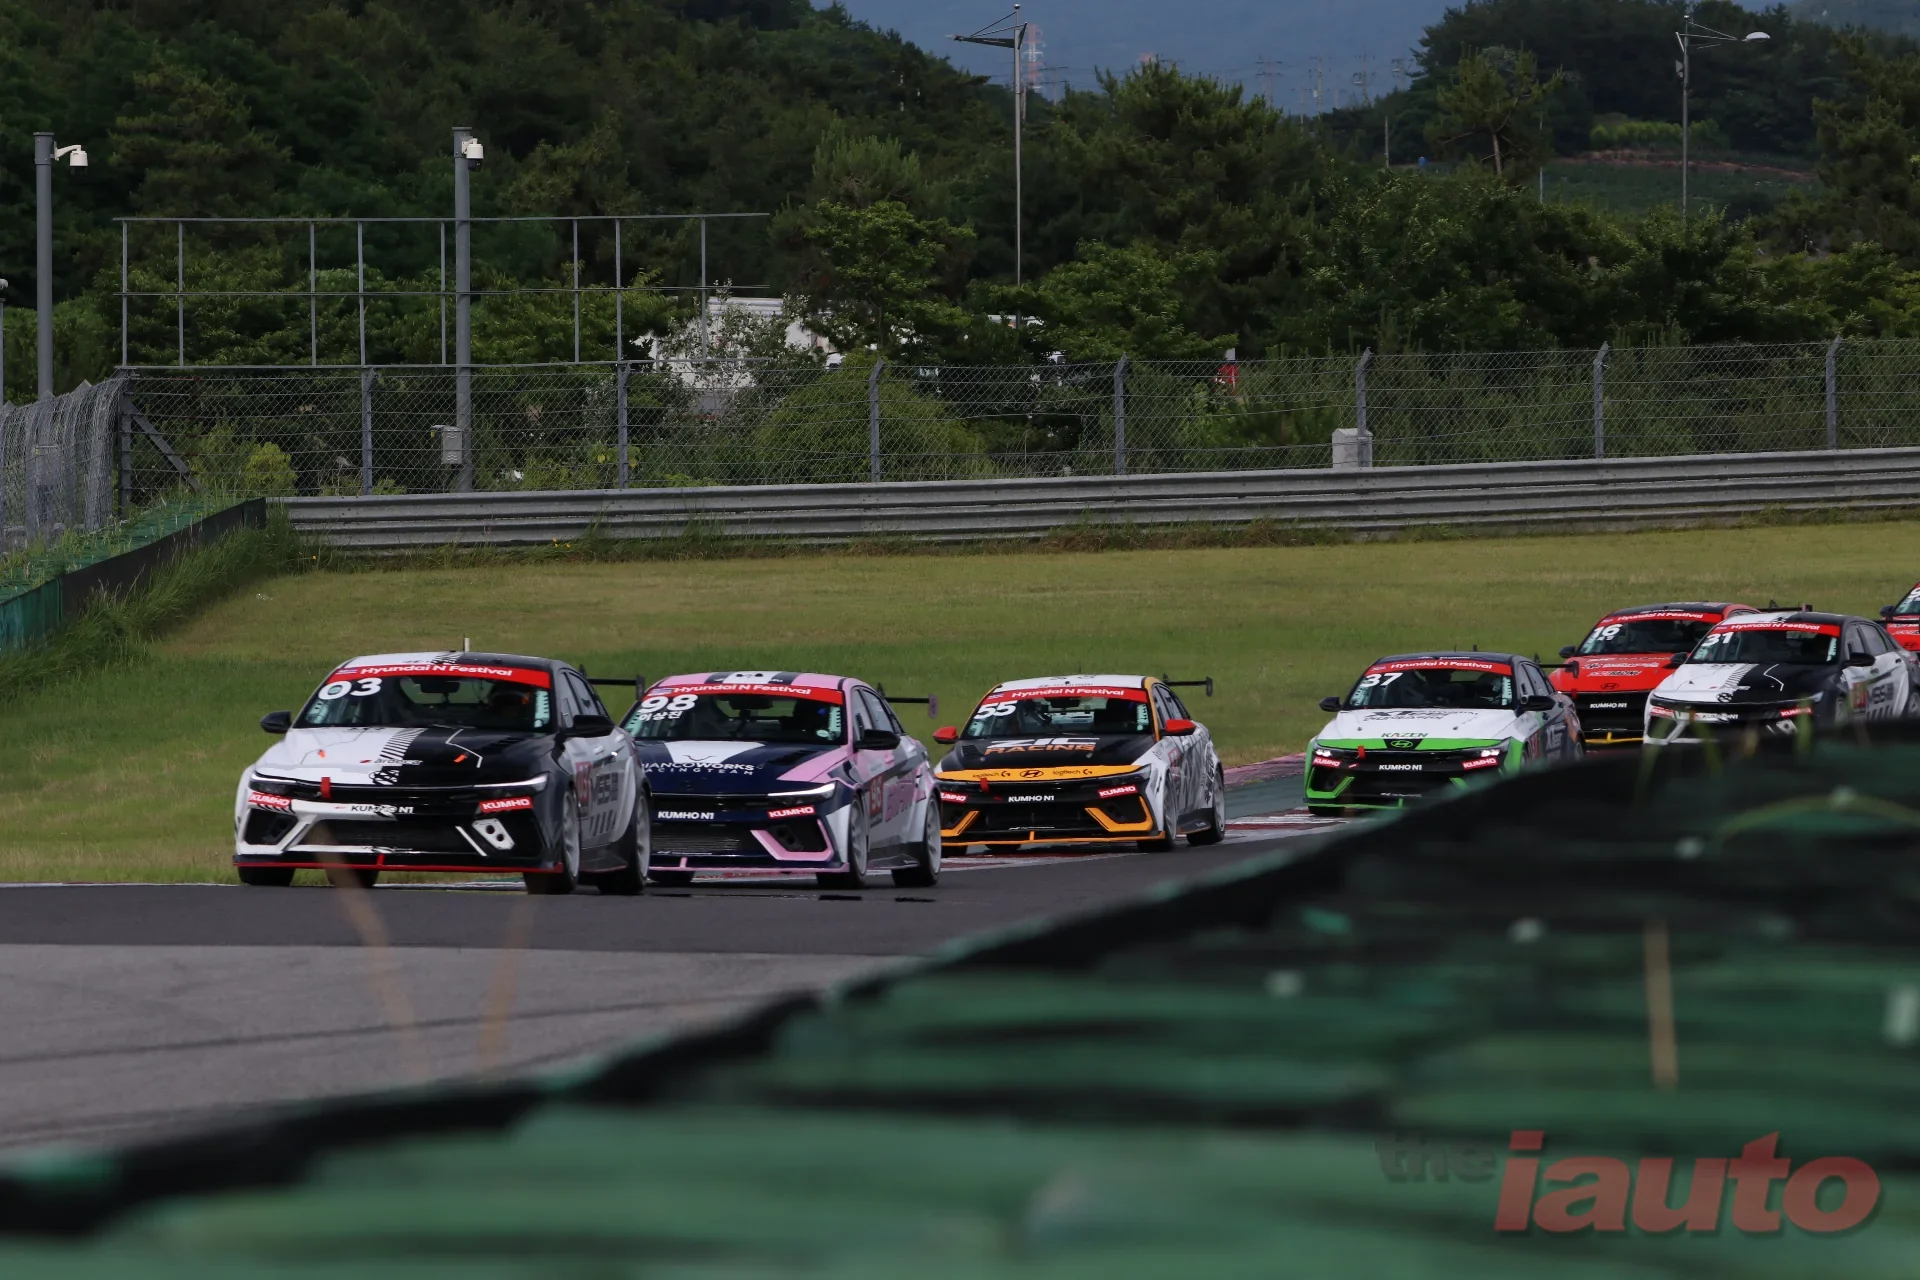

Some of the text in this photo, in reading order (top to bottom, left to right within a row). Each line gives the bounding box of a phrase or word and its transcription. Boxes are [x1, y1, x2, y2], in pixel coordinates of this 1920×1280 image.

[1617, 612, 1657, 620] Hyundai
[1593, 624, 1623, 638] 16
[1701, 632, 1734, 647] 31
[360, 665, 430, 675] Hyundai
[445, 665, 512, 676] Festival
[1391, 661, 1437, 669] Hyundai
[1450, 661, 1492, 669] Festival
[1360, 672, 1403, 687] 37
[318, 677, 382, 700] 03
[674, 684, 736, 693] Hyundai
[756, 685, 811, 694] Festival
[1012, 688, 1062, 698] Hyundai
[1077, 688, 1124, 696] Festival
[640, 694, 698, 713] 98
[974, 700, 1018, 719] 55
[986, 737, 1099, 748] ZIC
[984, 744, 1096, 755] RACING
[1314, 758, 1341, 767] KUMHO
[1463, 758, 1497, 769] KUMHO
[941, 793, 966, 801] UMHO
[1100, 786, 1136, 797] KUMHO
[250, 793, 290, 806] KUMHO
[482, 798, 530, 810] KUMHO
[1008, 795, 1042, 803] KUMHO
[398, 806, 414, 814] N1
[658, 811, 699, 819] KUMHO
[769, 806, 814, 818] KUMHO
